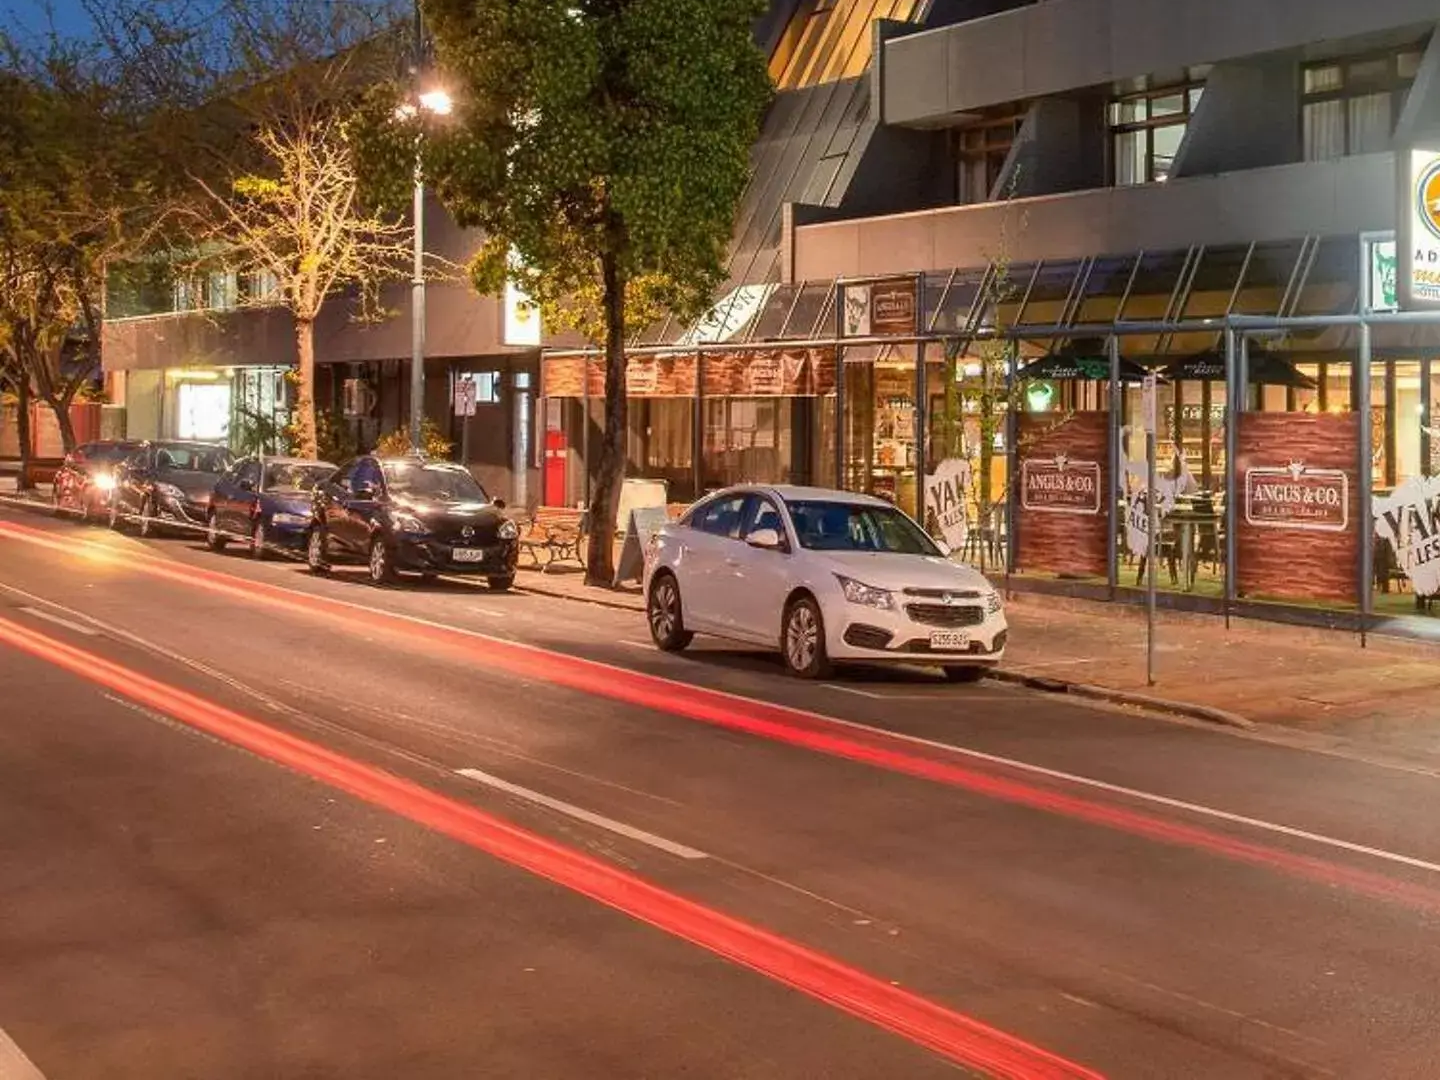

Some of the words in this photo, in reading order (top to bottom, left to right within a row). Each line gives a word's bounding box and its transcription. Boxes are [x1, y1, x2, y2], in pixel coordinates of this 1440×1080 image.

[1028, 473, 1065, 490] ANGUS
[1252, 484, 1301, 503] ANGUS
[1303, 486, 1314, 504] &
